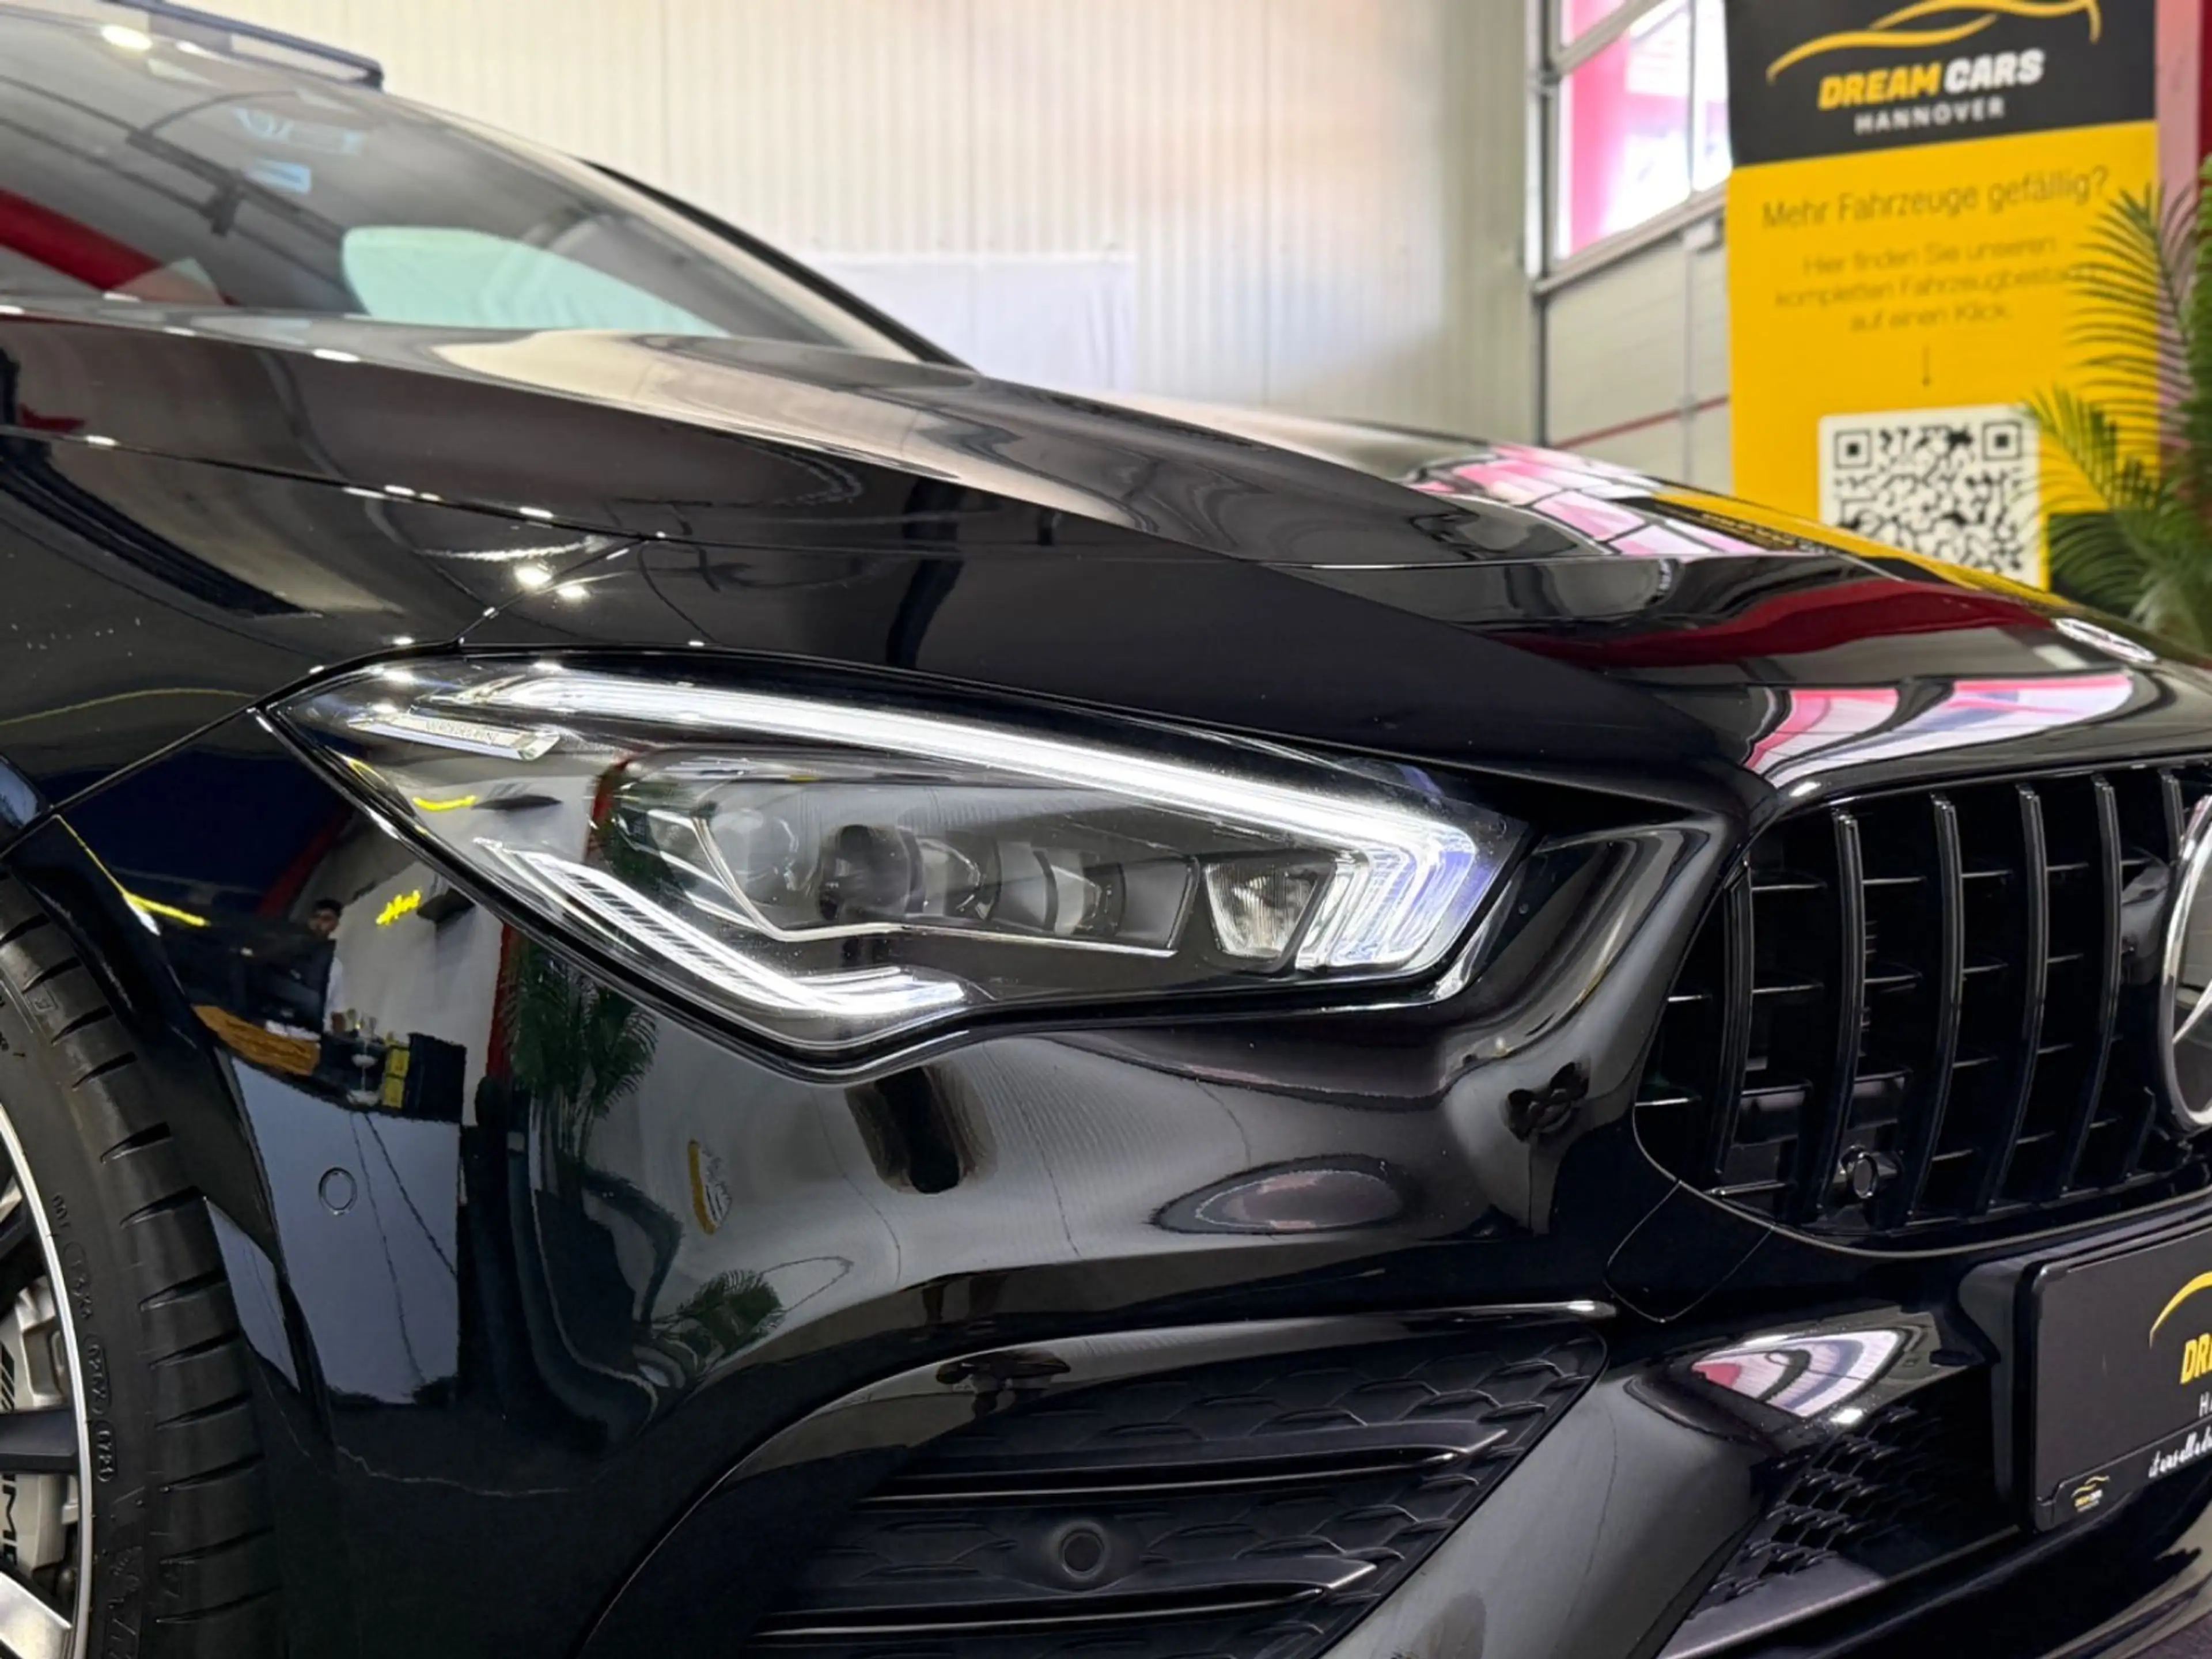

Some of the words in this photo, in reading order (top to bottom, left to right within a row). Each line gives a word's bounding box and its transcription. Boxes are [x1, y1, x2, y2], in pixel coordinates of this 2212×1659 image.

[1817, 60, 1942, 111] DREAM
[1944, 47, 2046, 94] CARS
[1854, 94, 2005, 136] HANNOVER
[1763, 198, 1829, 227] Mehr
[1839, 186, 1978, 221] Fahrzeuge
[1987, 165, 2108, 214] gefällig?
[1802, 253, 1845, 275] Hier
[1854, 249, 1918, 271] finden
[1923, 242, 1959, 265] Sie
[1967, 237, 2056, 260] unseren
[1889, 308, 1947, 329] einen
[2180, 1332, 2212, 1385] DR
[2199, 1391, 2212, 1418] H
